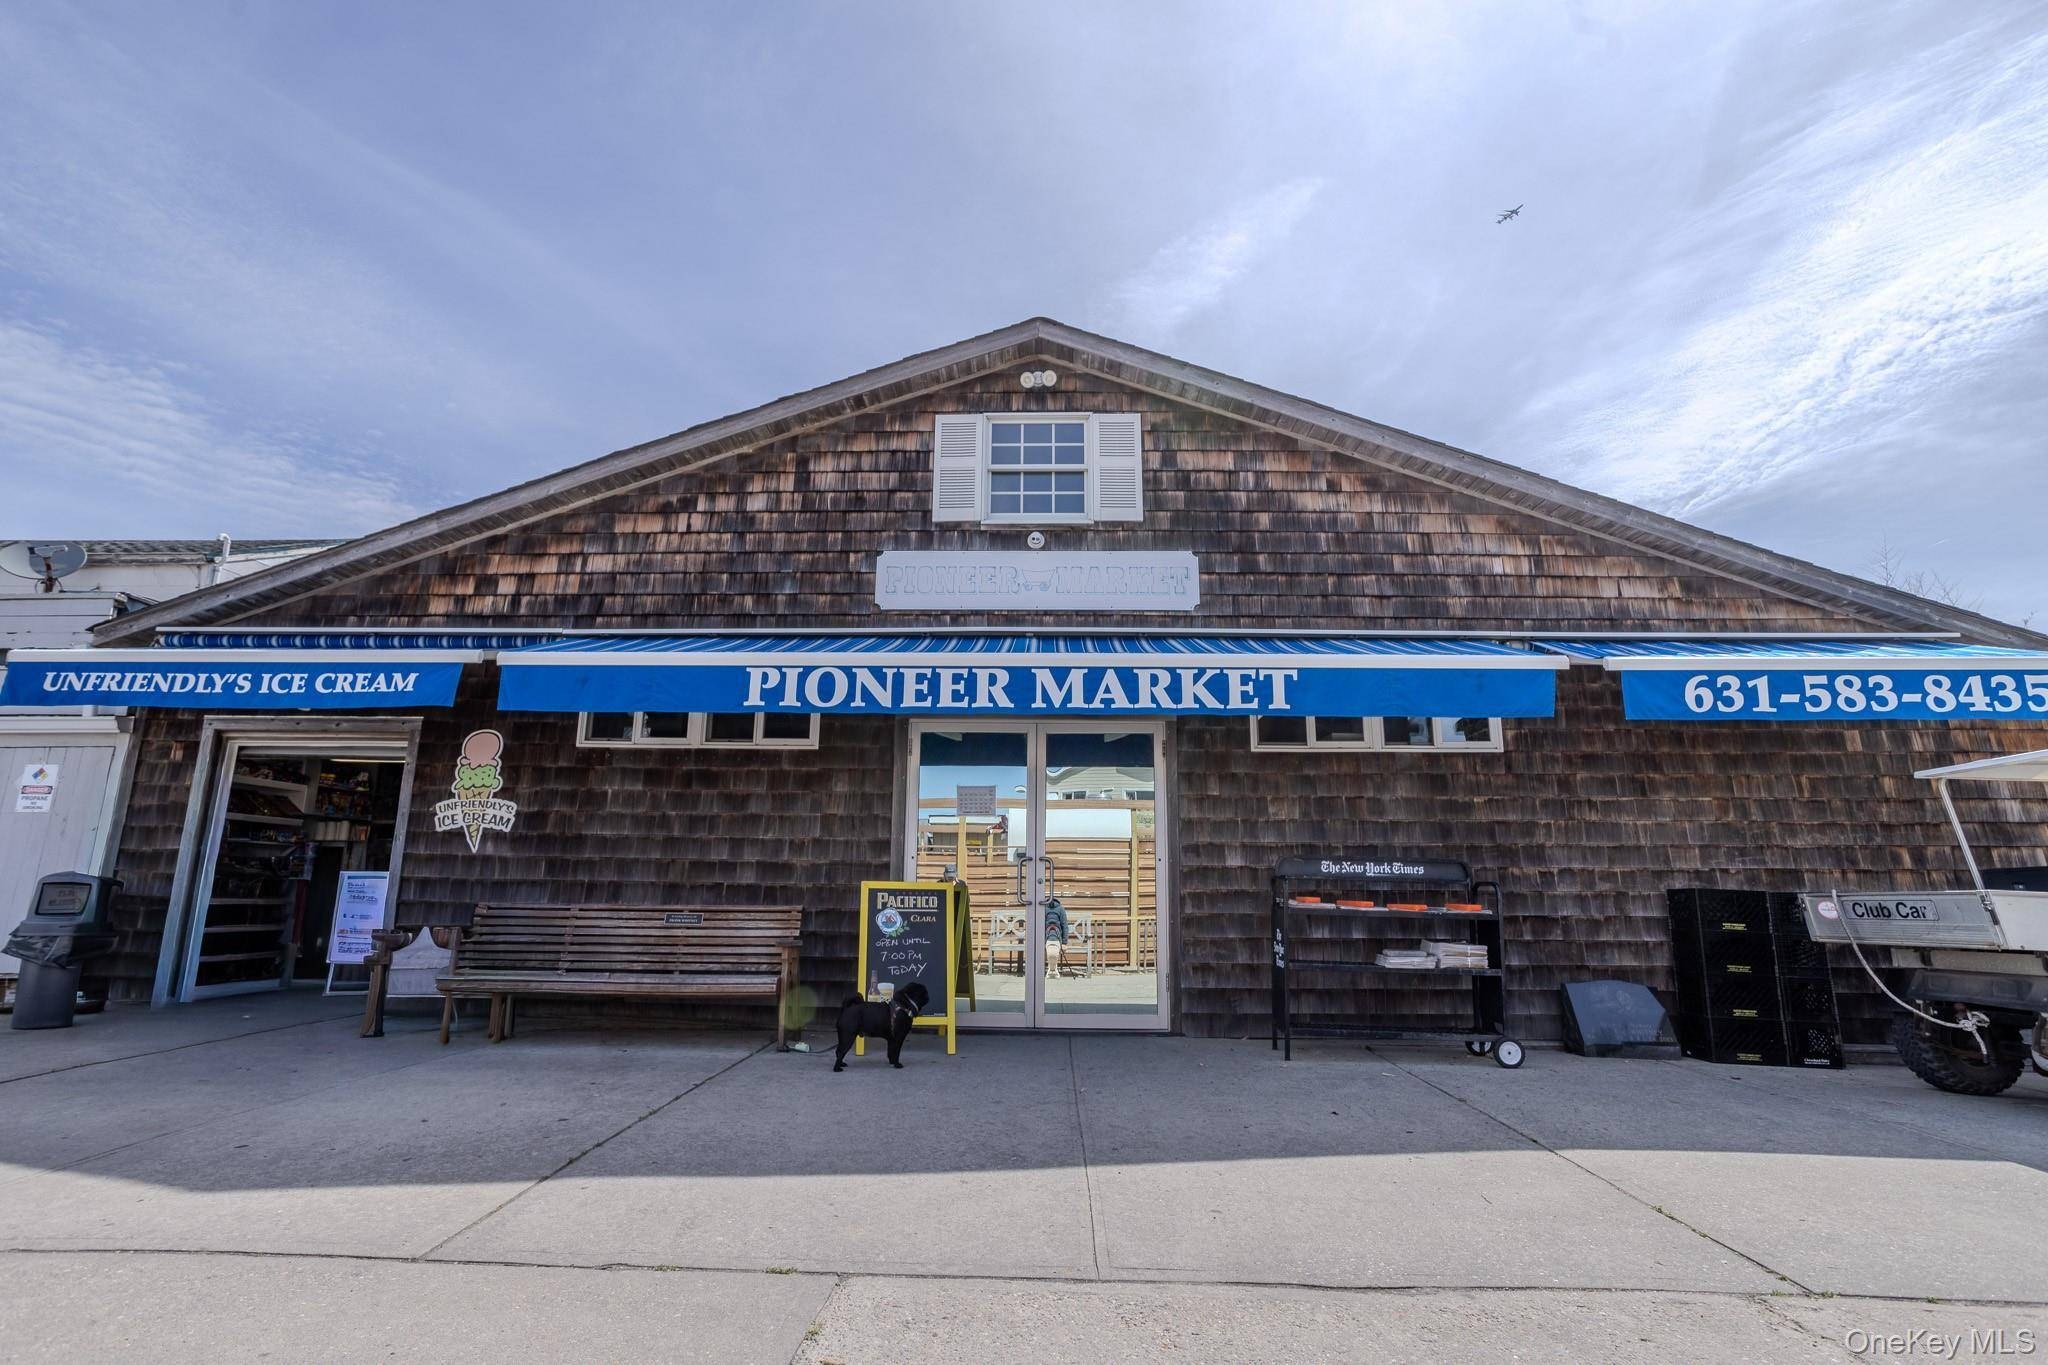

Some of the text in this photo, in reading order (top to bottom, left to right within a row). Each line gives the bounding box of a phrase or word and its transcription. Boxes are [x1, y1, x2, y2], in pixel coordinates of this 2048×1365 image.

[886, 566, 1189, 593] PIONEER MARKET
[42, 672, 419, 694] UNFRIENDLY'S ICE CREAM
[742, 667, 1298, 709] PIONEER MARKET
[1684, 674, 2048, 713] 631-583-8435
[439, 799, 514, 814] UNFRIENDLY'S
[438, 811, 512, 830] ICE CREAM
[1320, 861, 1425, 876] The New York Times
[1852, 902, 1892, 918] Club
[1896, 902, 1928, 919] Car
[902, 937, 931, 945] UNTIL
[880, 951, 905, 961] 7:00
